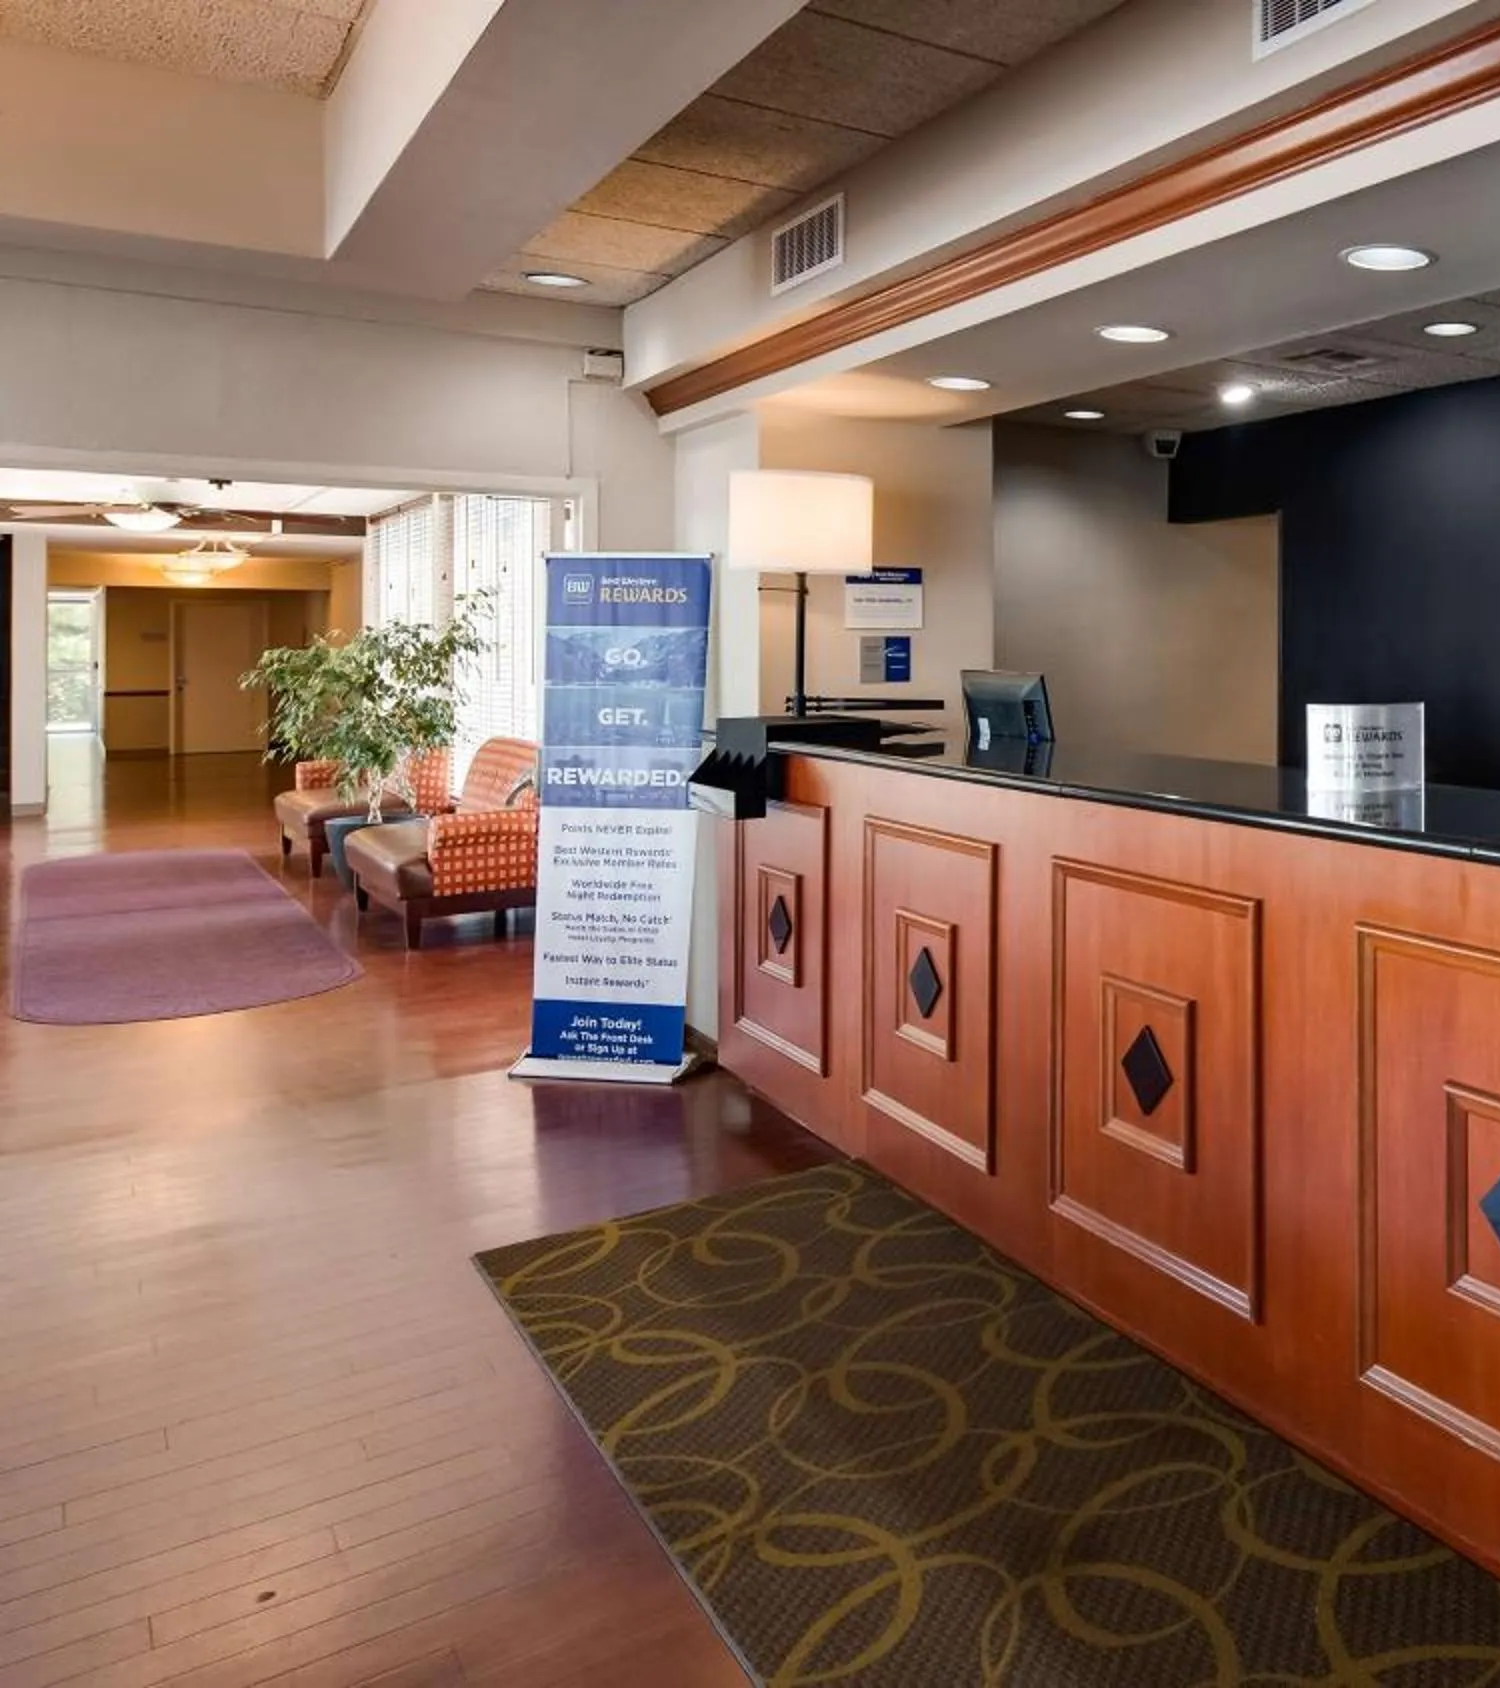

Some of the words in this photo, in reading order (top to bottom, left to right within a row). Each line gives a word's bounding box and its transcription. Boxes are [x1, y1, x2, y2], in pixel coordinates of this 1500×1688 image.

[600, 587, 688, 604] REWARDS
[605, 647, 649, 667] GO.
[598, 707, 649, 726] GET.
[547, 767, 687, 788] REWARDED.
[596, 824, 633, 835] NEVER
[572, 879, 628, 890] Worldwide
[598, 891, 661, 902] Redemption
[622, 913, 637, 923] No
[581, 954, 603, 966] Way
[605, 956, 617, 965] to
[570, 1015, 597, 1028] Join
[600, 1017, 642, 1032] Today!
[559, 1030, 578, 1040] Ask
[580, 1031, 599, 1041] The
[601, 1033, 628, 1043] Front
[630, 1034, 654, 1045] Desk
[587, 1043, 609, 1055] Sign
[627, 1046, 638, 1055] at
